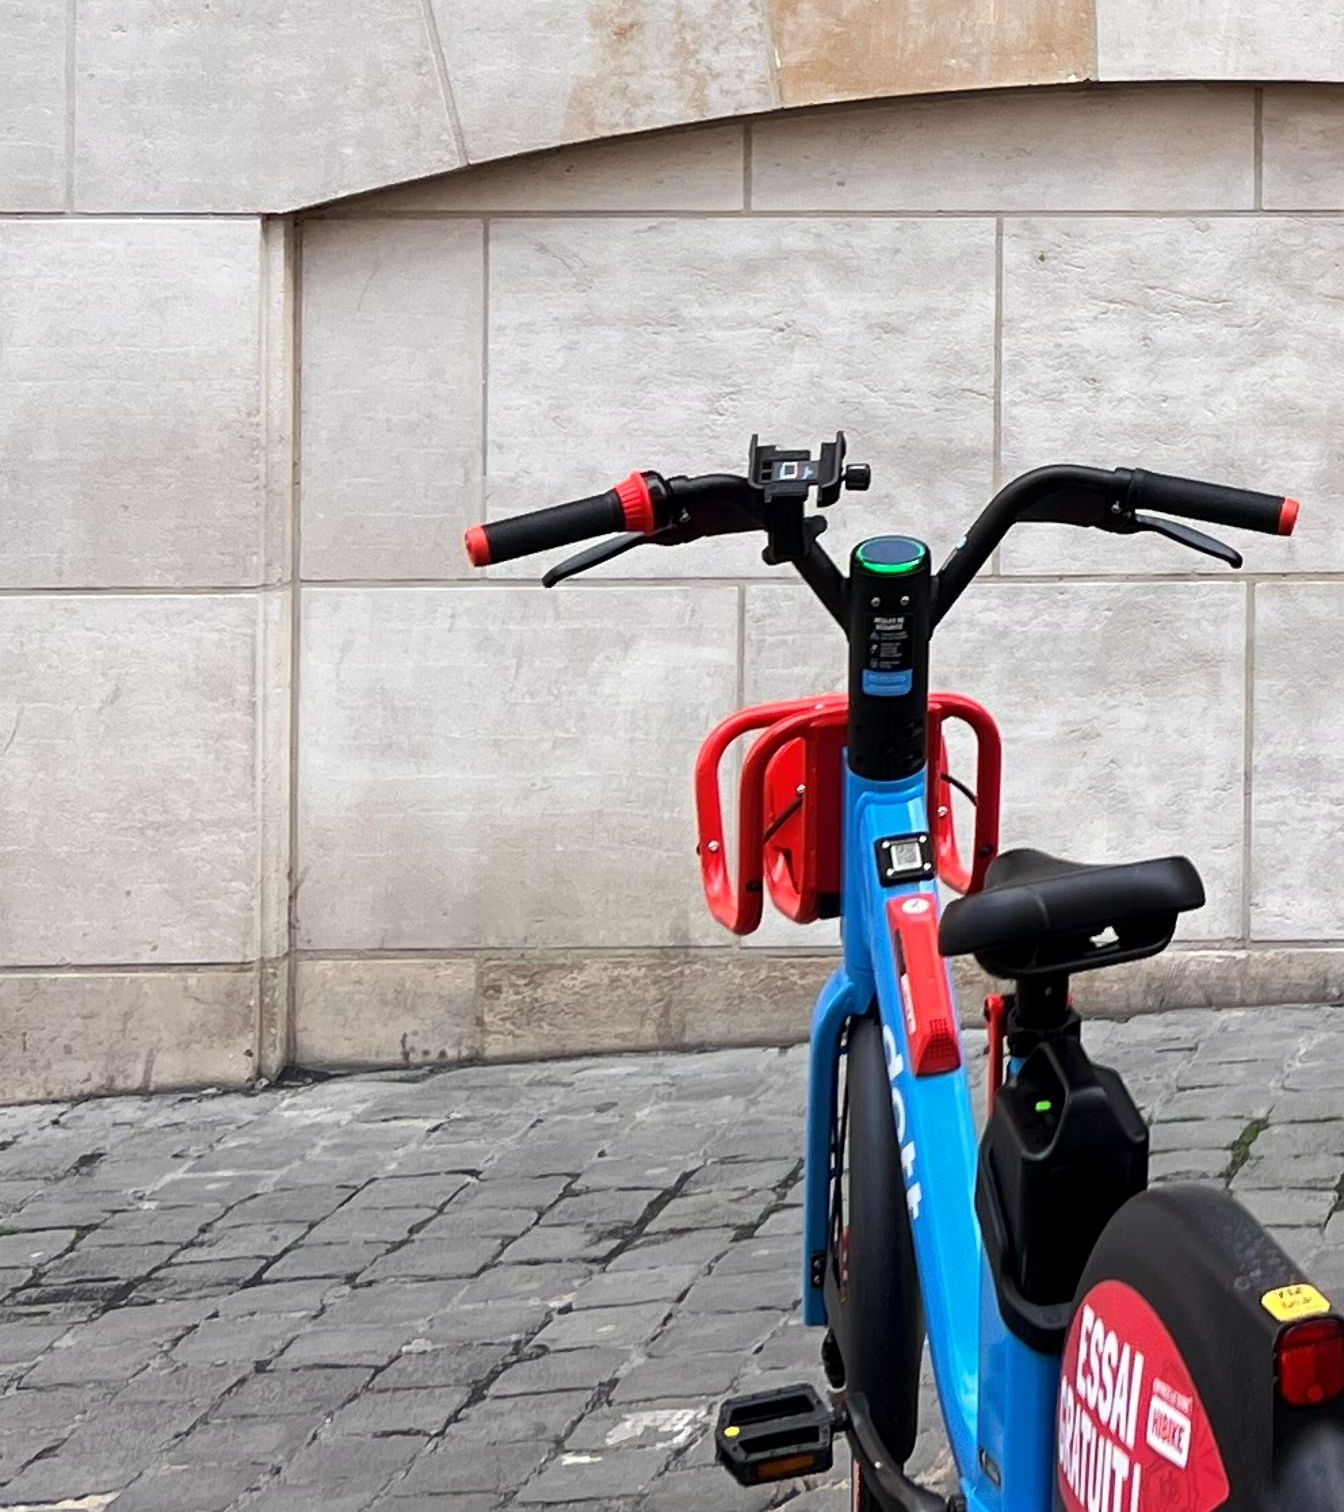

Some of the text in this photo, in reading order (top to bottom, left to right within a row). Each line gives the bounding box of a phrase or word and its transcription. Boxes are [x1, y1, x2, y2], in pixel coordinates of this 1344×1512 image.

[883, 1023, 922, 1220] dott
[1059, 1374, 1130, 1512] GRATUIT
[1076, 1304, 1144, 1451] ESSAI
